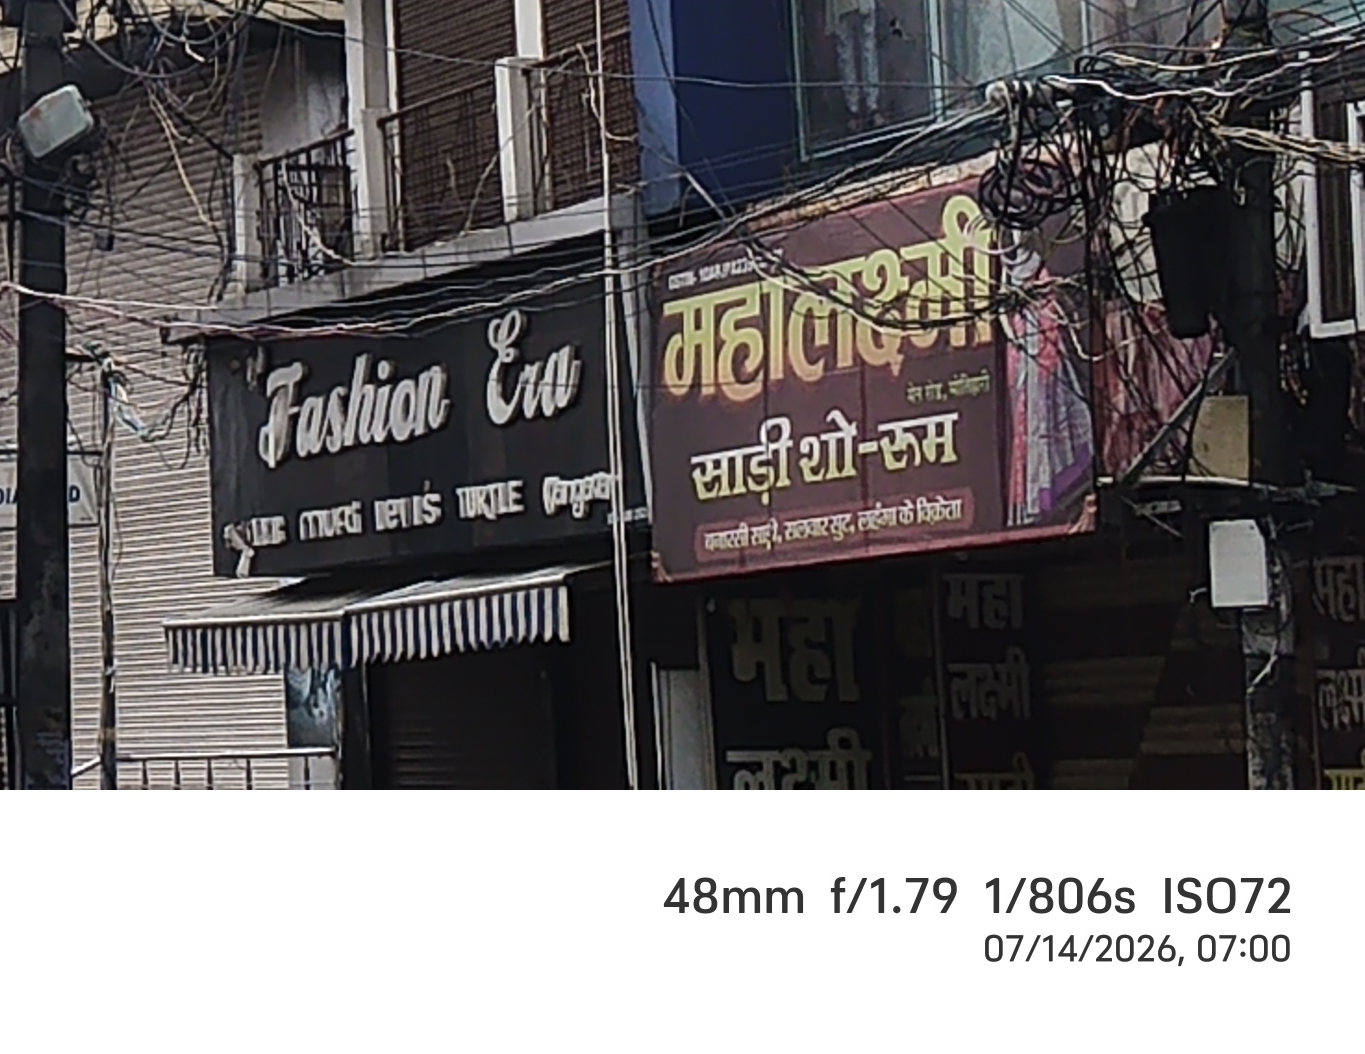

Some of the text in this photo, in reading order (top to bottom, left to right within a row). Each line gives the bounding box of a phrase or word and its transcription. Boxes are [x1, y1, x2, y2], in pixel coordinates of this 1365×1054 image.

[663, 194, 994, 402] महालक्ष्मी
[257, 308, 583, 469] Fashion Era
[456, 479, 526, 521] TURTLE
[691, 416, 793, 505] साड़ी
[727, 594, 863, 702] महा
